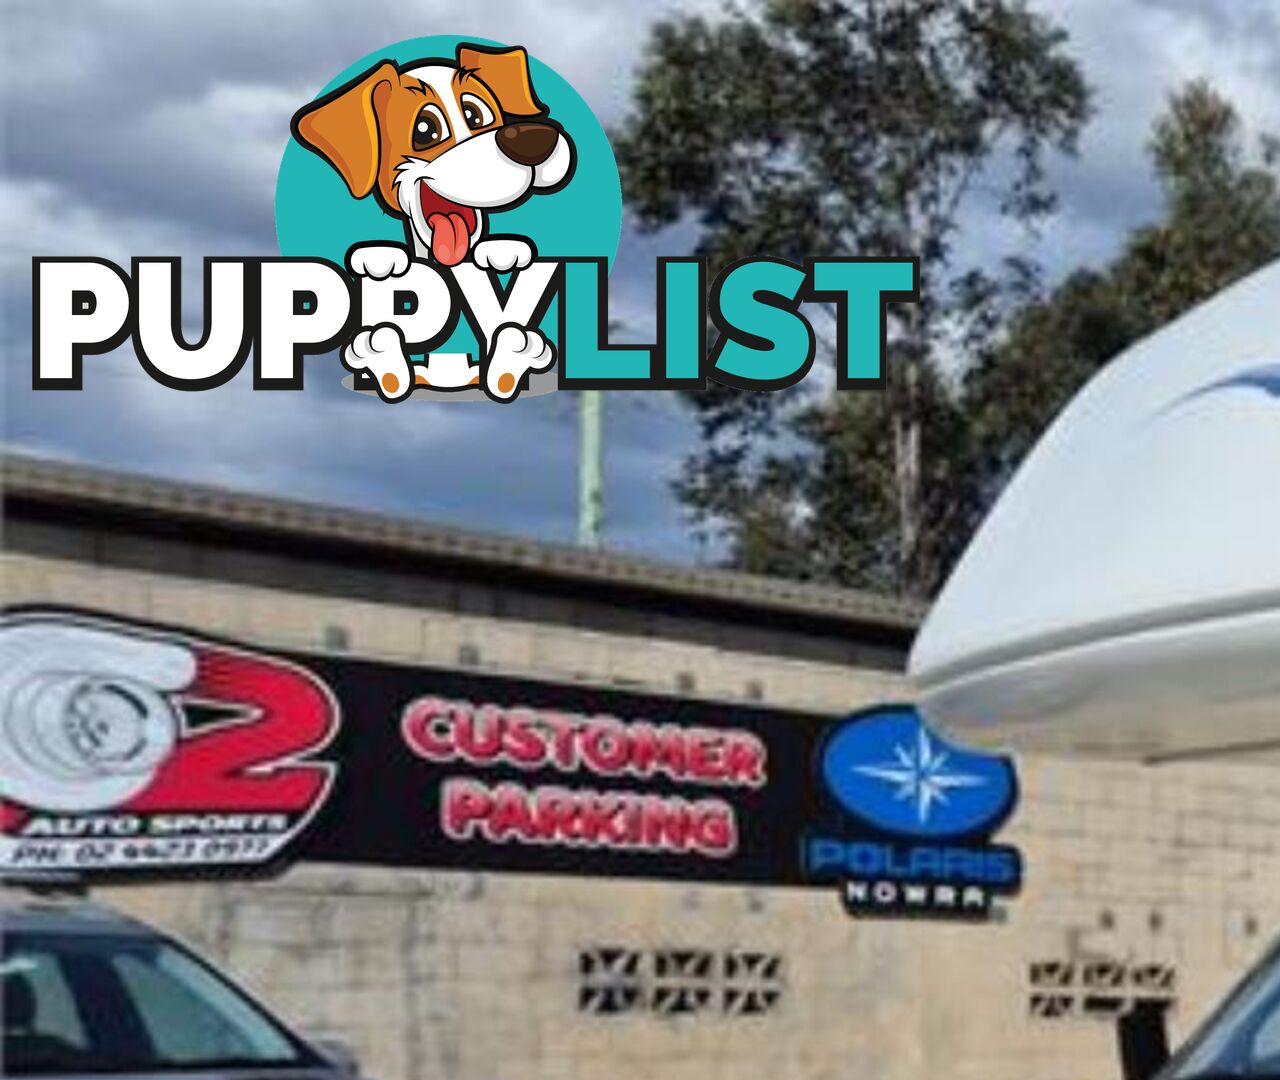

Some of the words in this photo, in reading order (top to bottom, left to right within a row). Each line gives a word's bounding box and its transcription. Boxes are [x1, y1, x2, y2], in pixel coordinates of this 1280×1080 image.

[401, 697, 766, 785] CUSTOMER
[21, 816, 140, 836] AUTO
[151, 813, 289, 833] SPORTS
[439, 777, 735, 855] PARKING
[75, 842, 115, 865] 02
[807, 838, 1016, 882] POLARIS
[846, 881, 986, 908] NOWRA
